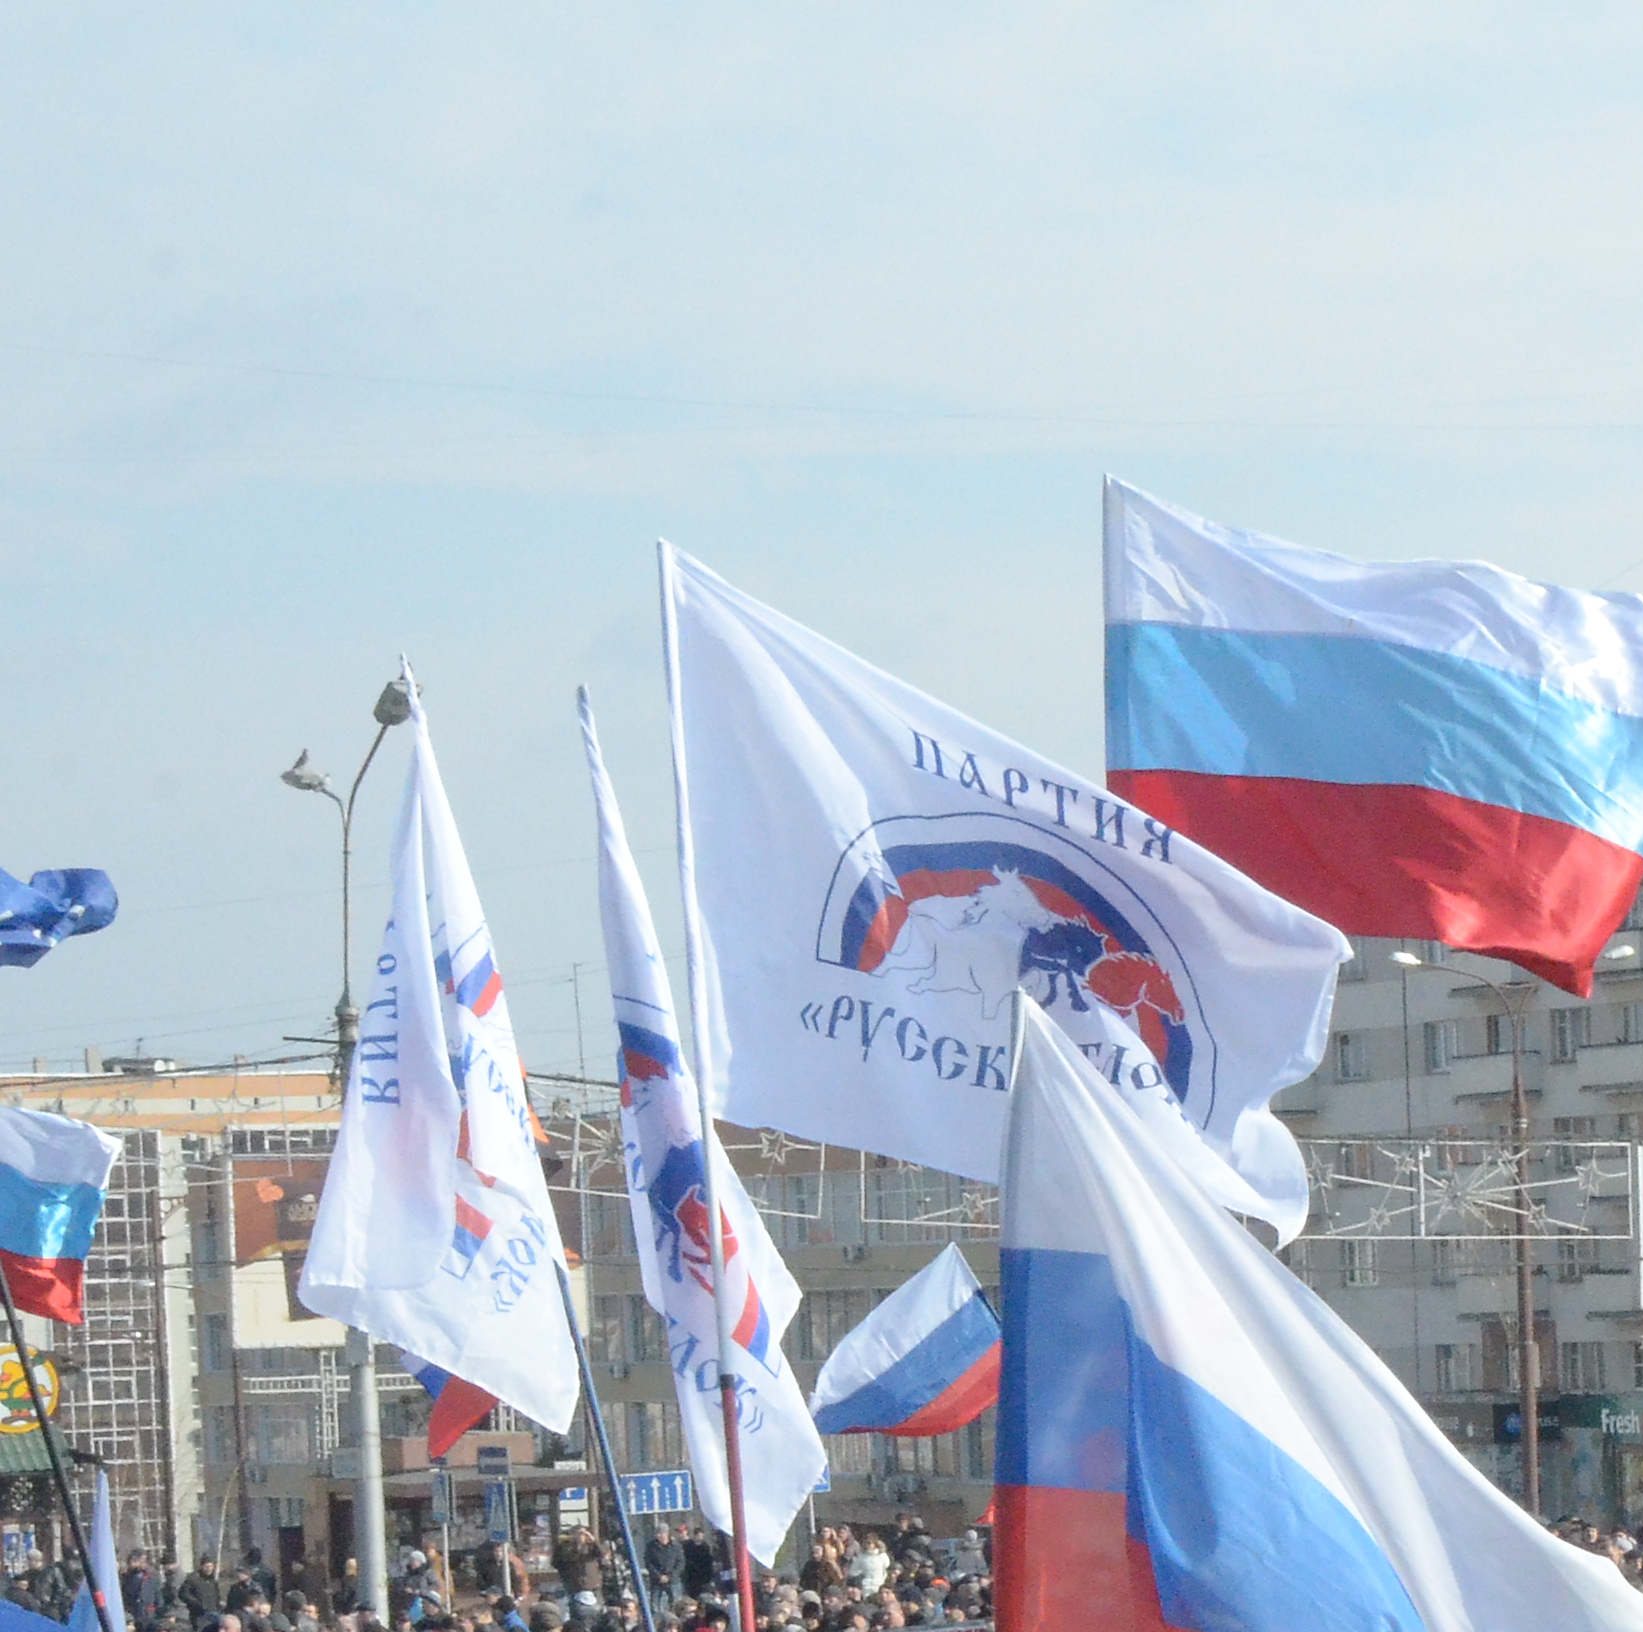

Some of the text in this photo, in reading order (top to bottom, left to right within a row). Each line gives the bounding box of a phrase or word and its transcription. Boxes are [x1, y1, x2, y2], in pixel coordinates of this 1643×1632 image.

[909, 726, 1180, 866] ПАРТИЯ
[799, 994, 1009, 1093] «РУССК
[1602, 1408, 1640, 1434] Fresh
